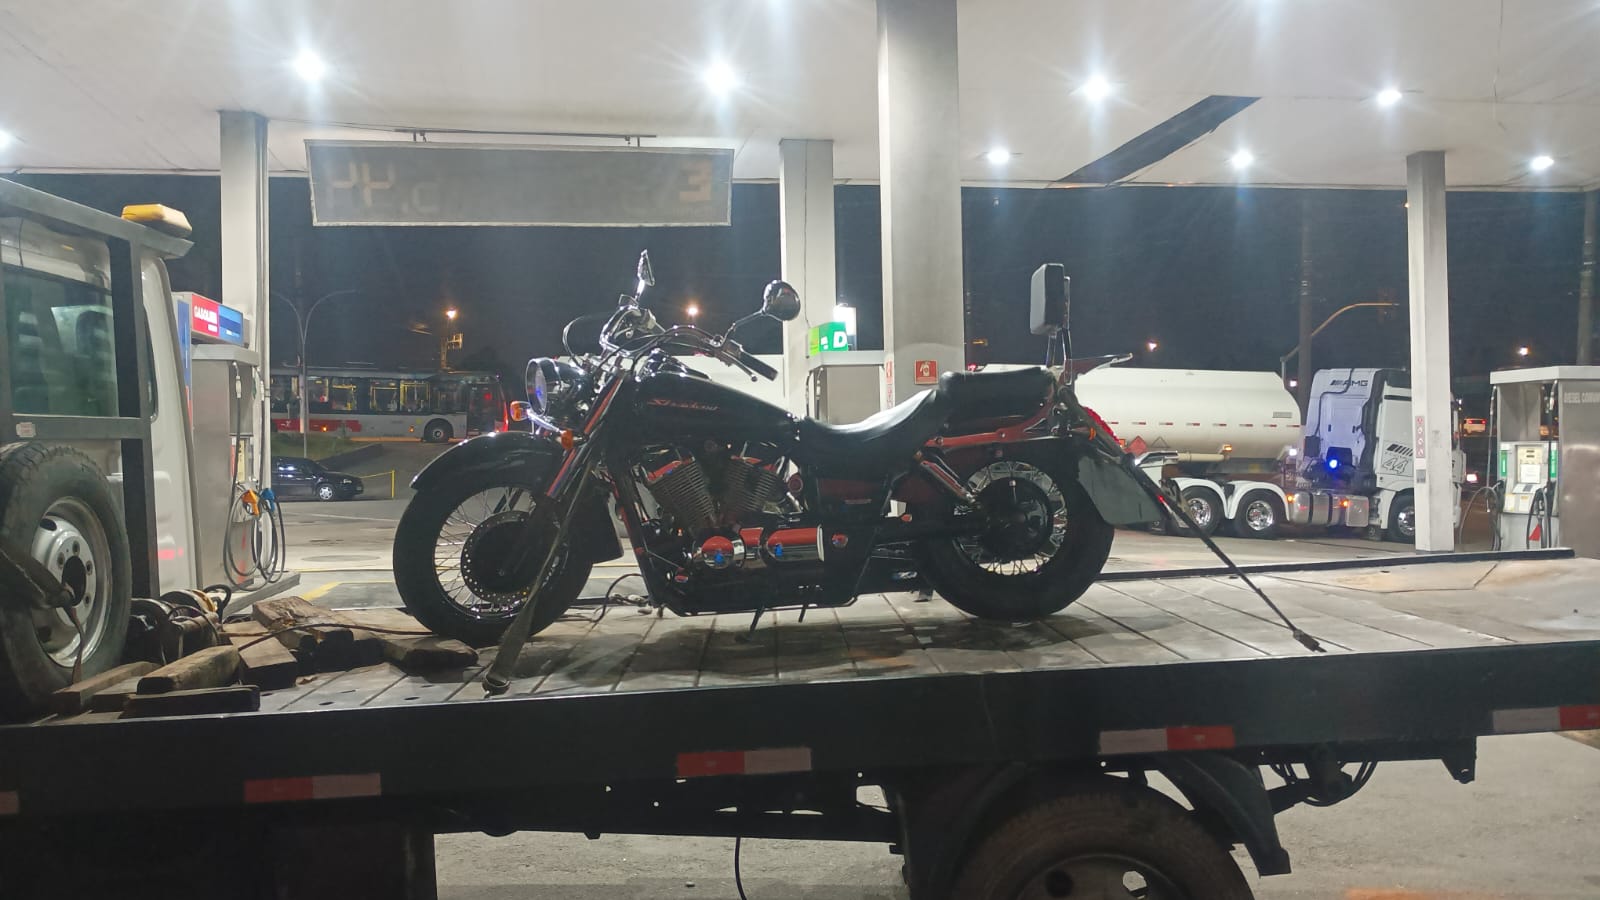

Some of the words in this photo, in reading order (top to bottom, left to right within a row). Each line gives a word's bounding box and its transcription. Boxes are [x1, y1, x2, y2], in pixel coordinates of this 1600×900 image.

[193, 305, 218, 325] GASOL
[1342, 379, 1369, 387] AMG
[1382, 457, 1408, 475] 44
